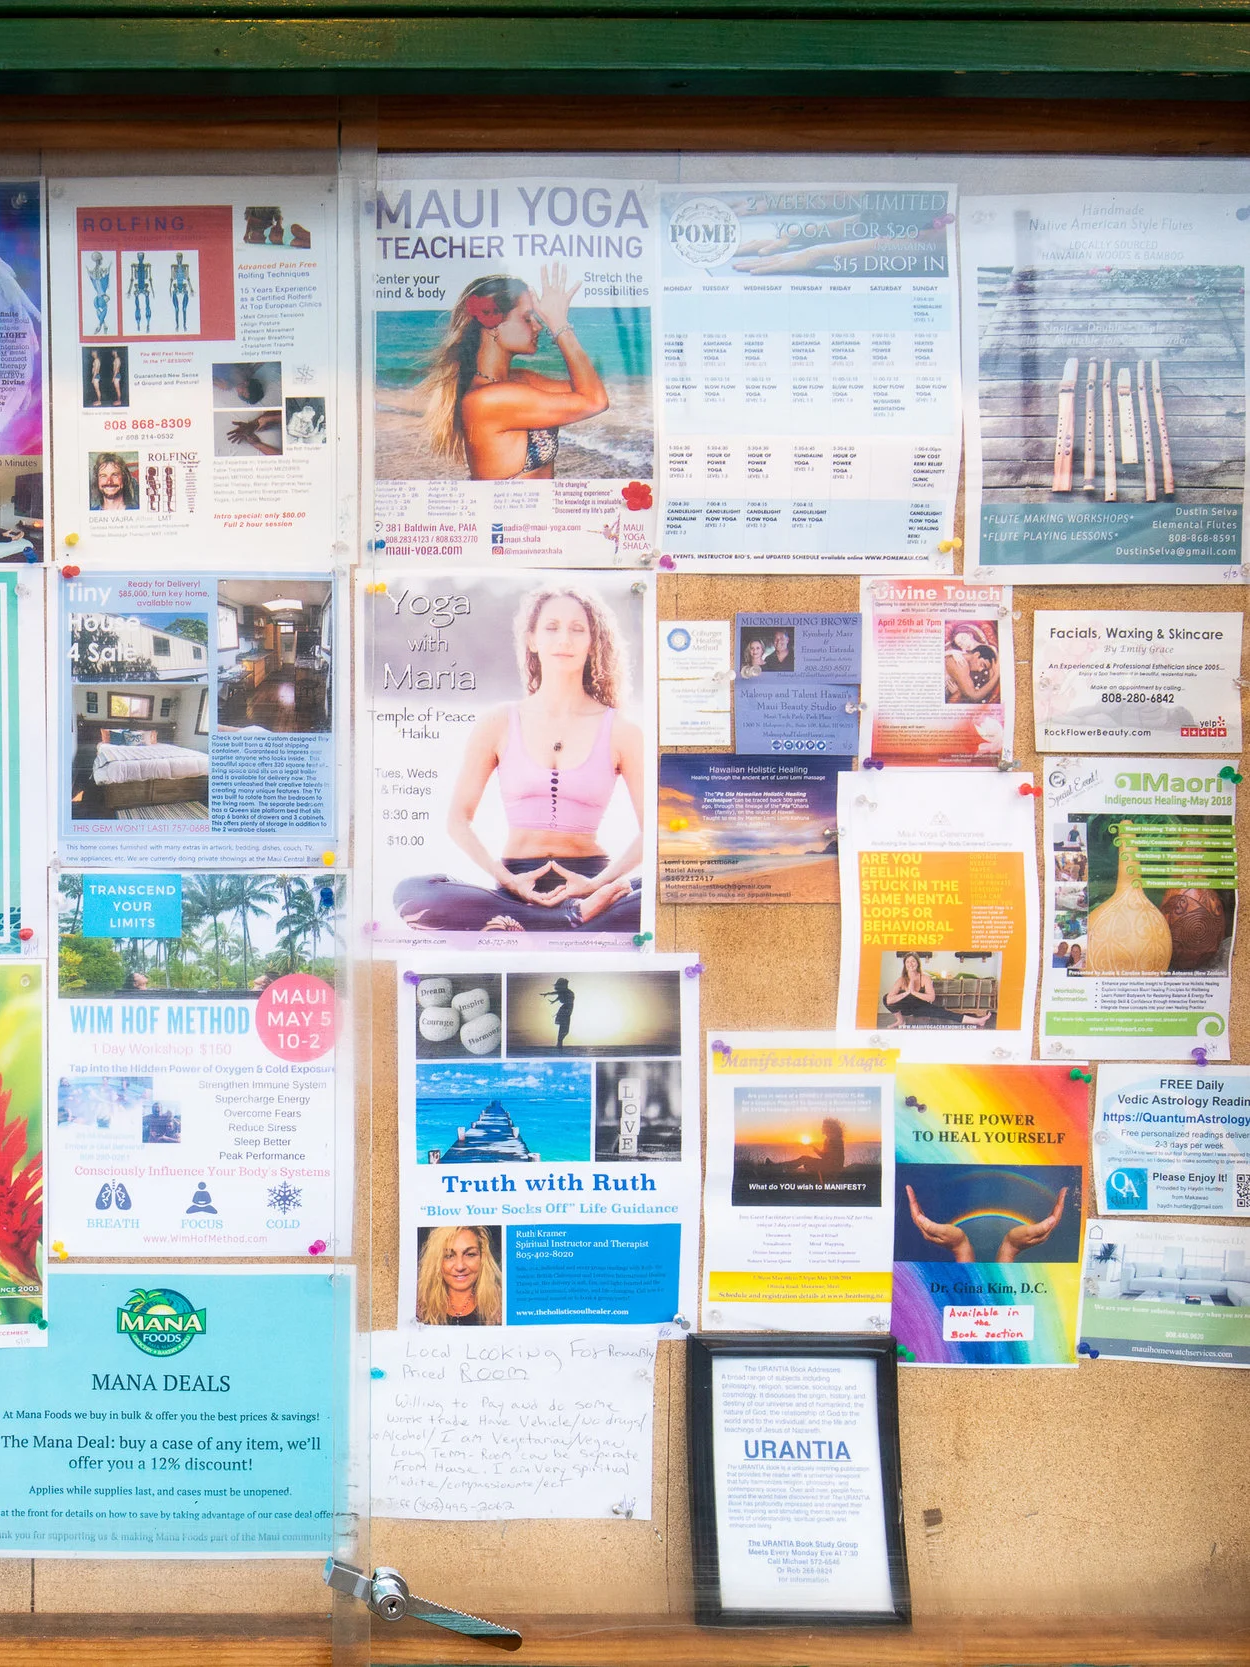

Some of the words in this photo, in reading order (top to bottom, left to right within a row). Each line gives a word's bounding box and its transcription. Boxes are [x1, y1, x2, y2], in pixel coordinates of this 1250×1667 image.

[374, 186, 498, 230] MAUI
[516, 186, 649, 229] YOGA
[670, 222, 737, 244] POME
[378, 236, 503, 260] TEACHER
[512, 234, 642, 258] TRAINING
[831, 257, 857, 273] $15
[864, 255, 917, 271] DROP
[923, 255, 944, 271] IN
[104, 420, 126, 430] 808
[131, 417, 191, 430] 868-8309
[4, 459, 37, 467] Minutes
[1175, 507, 1208, 516] Dustin
[1211, 507, 1237, 516] Selva
[385, 523, 400, 532] 381
[404, 523, 436, 532] Baldwin
[439, 523, 455, 532] Ave,
[458, 523, 477, 531] PAIA
[1152, 519, 1202, 529] Elemental
[1206, 520, 1237, 529] Flutes
[1168, 533, 1235, 542] 808-868-8591
[1115, 546, 1236, 557] DustinSelva@gmail.com
[391, 589, 470, 629] Yoga
[877, 618, 895, 627] April
[896, 617, 914, 626] 26th
[916, 618, 923, 626] at
[925, 618, 941, 627] 7pm
[1050, 627, 1100, 639] Facials,
[1105, 627, 1152, 642] Waxing
[1156, 628, 1164, 639] &
[1168, 628, 1223, 640] Skincare
[407, 633, 448, 652] with
[1101, 692, 1174, 703] 808-280-6842
[417, 707, 432, 727] of
[436, 711, 475, 722] Peace
[1198, 719, 1217, 731] yelp
[402, 725, 439, 739] Haiku
[1044, 728, 1151, 738] RockFlowerBeauty.com
[709, 766, 745, 774] Hawaiian
[747, 765, 776, 774] Holistic
[778, 766, 808, 775] Healing
[1142, 772, 1225, 793] Maori
[1104, 794, 1152, 807] Indigenous
[1154, 794, 1209, 808] Healing-May
[1210, 795, 1232, 806] 2018
[387, 835, 424, 846] $10.00
[89, 884, 175, 895] TRANSCEND
[861, 879, 909, 891] STUCK
[912, 879, 927, 891] IN
[930, 880, 958, 892] THE
[112, 901, 151, 912] YOUR
[110, 917, 155, 928] LIMITS
[862, 933, 944, 945] PATTERNS?
[271, 989, 326, 1005] MAUI
[69, 1005, 113, 1034] WIM
[121, 1005, 160, 1034] HOF
[167, 1006, 249, 1034] METHOD
[267, 1011, 313, 1027] MAY
[320, 1011, 330, 1026] 5
[277, 1033, 320, 1049] 10-2
[1160, 1078, 1192, 1090] FREE
[1196, 1080, 1225, 1091] Daily
[942, 1113, 974, 1125] THE
[979, 1113, 1034, 1126] POWER
[912, 1130, 933, 1142] TO
[938, 1130, 980, 1142] HEAL
[983, 1131, 1065, 1144] YOURSELF
[441, 1174, 516, 1193] Truth
[524, 1172, 584, 1191] with
[592, 1172, 656, 1191] Ruth
[1152, 1172, 1185, 1181] Please
[1188, 1172, 1215, 1184] Enjoy
[1218, 1173, 1227, 1182] It!
[86, 1218, 139, 1229] BREATH
[181, 1218, 223, 1229] FOCUS
[265, 1218, 300, 1229] COLD
[516, 1229, 535, 1238] Ruth
[537, 1229, 567, 1237] Kramer
[515, 1249, 574, 1260] 805-402-8020
[1132, 1345, 1234, 1359] mauihomewatchservices.com
[91, 1373, 157, 1391] MANA
[163, 1374, 230, 1392] DEALS
[744, 1439, 851, 1461] URANTIA
